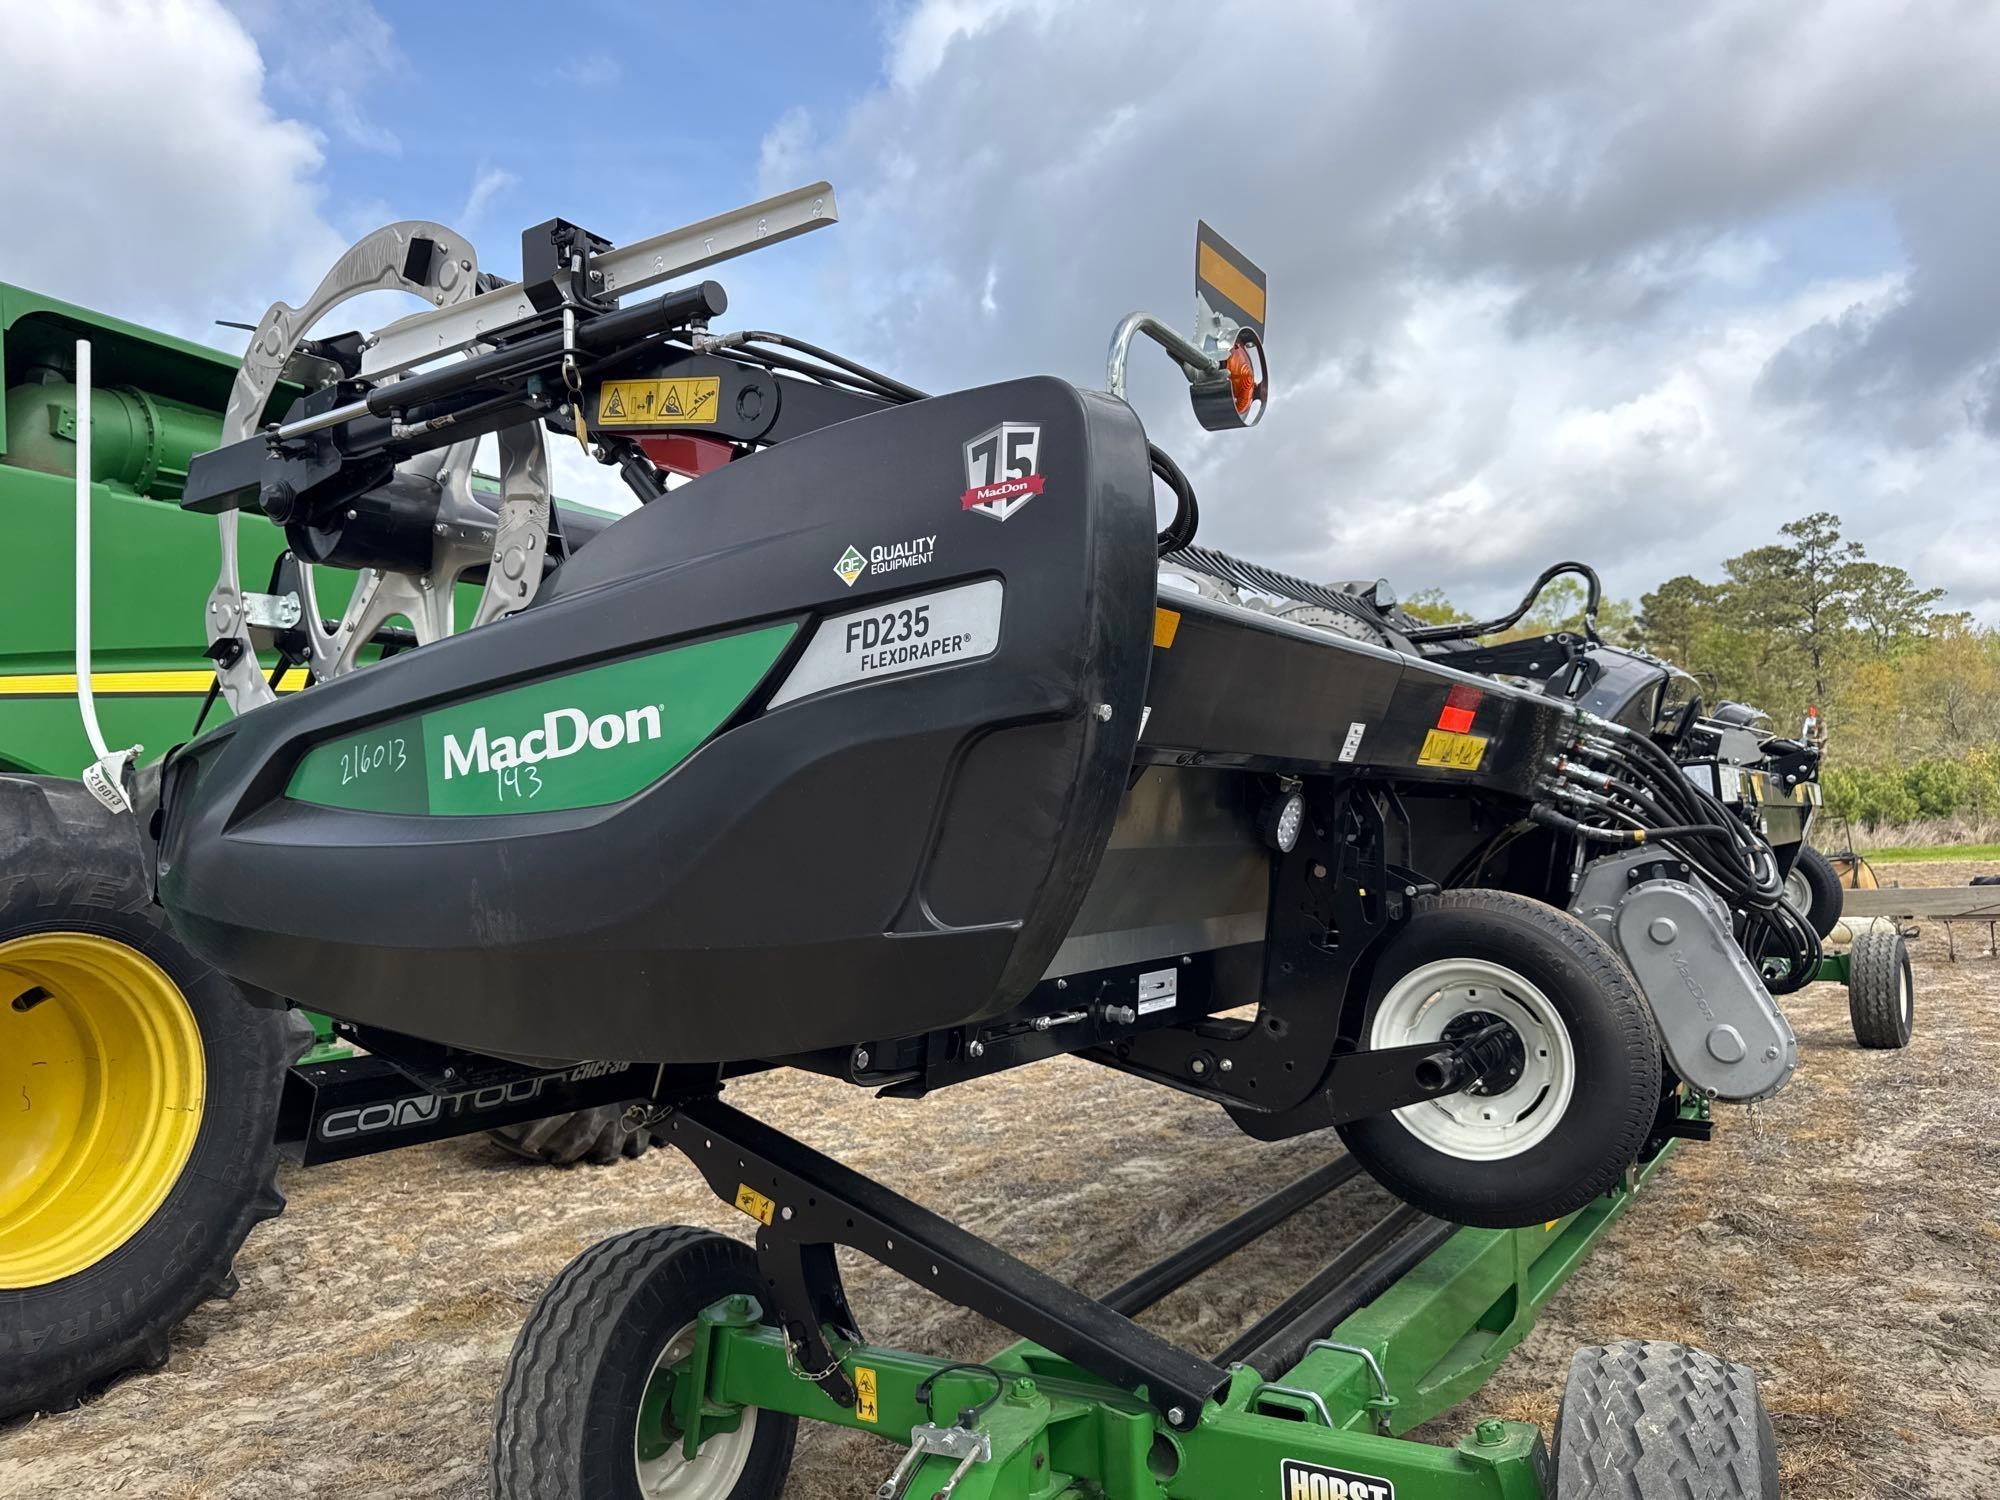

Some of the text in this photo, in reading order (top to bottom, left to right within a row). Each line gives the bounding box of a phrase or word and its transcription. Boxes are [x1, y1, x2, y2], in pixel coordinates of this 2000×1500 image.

[971, 431, 1035, 509] 75
[977, 482, 1028, 500] MacDon
[870, 535, 937, 563] QUALITY
[871, 551, 934, 575] EQUIPMENT
[840, 556, 860, 574] QE
[845, 604, 930, 654] FD235
[340, 738, 407, 785] 216013
[90, 773, 122, 806] 216013
